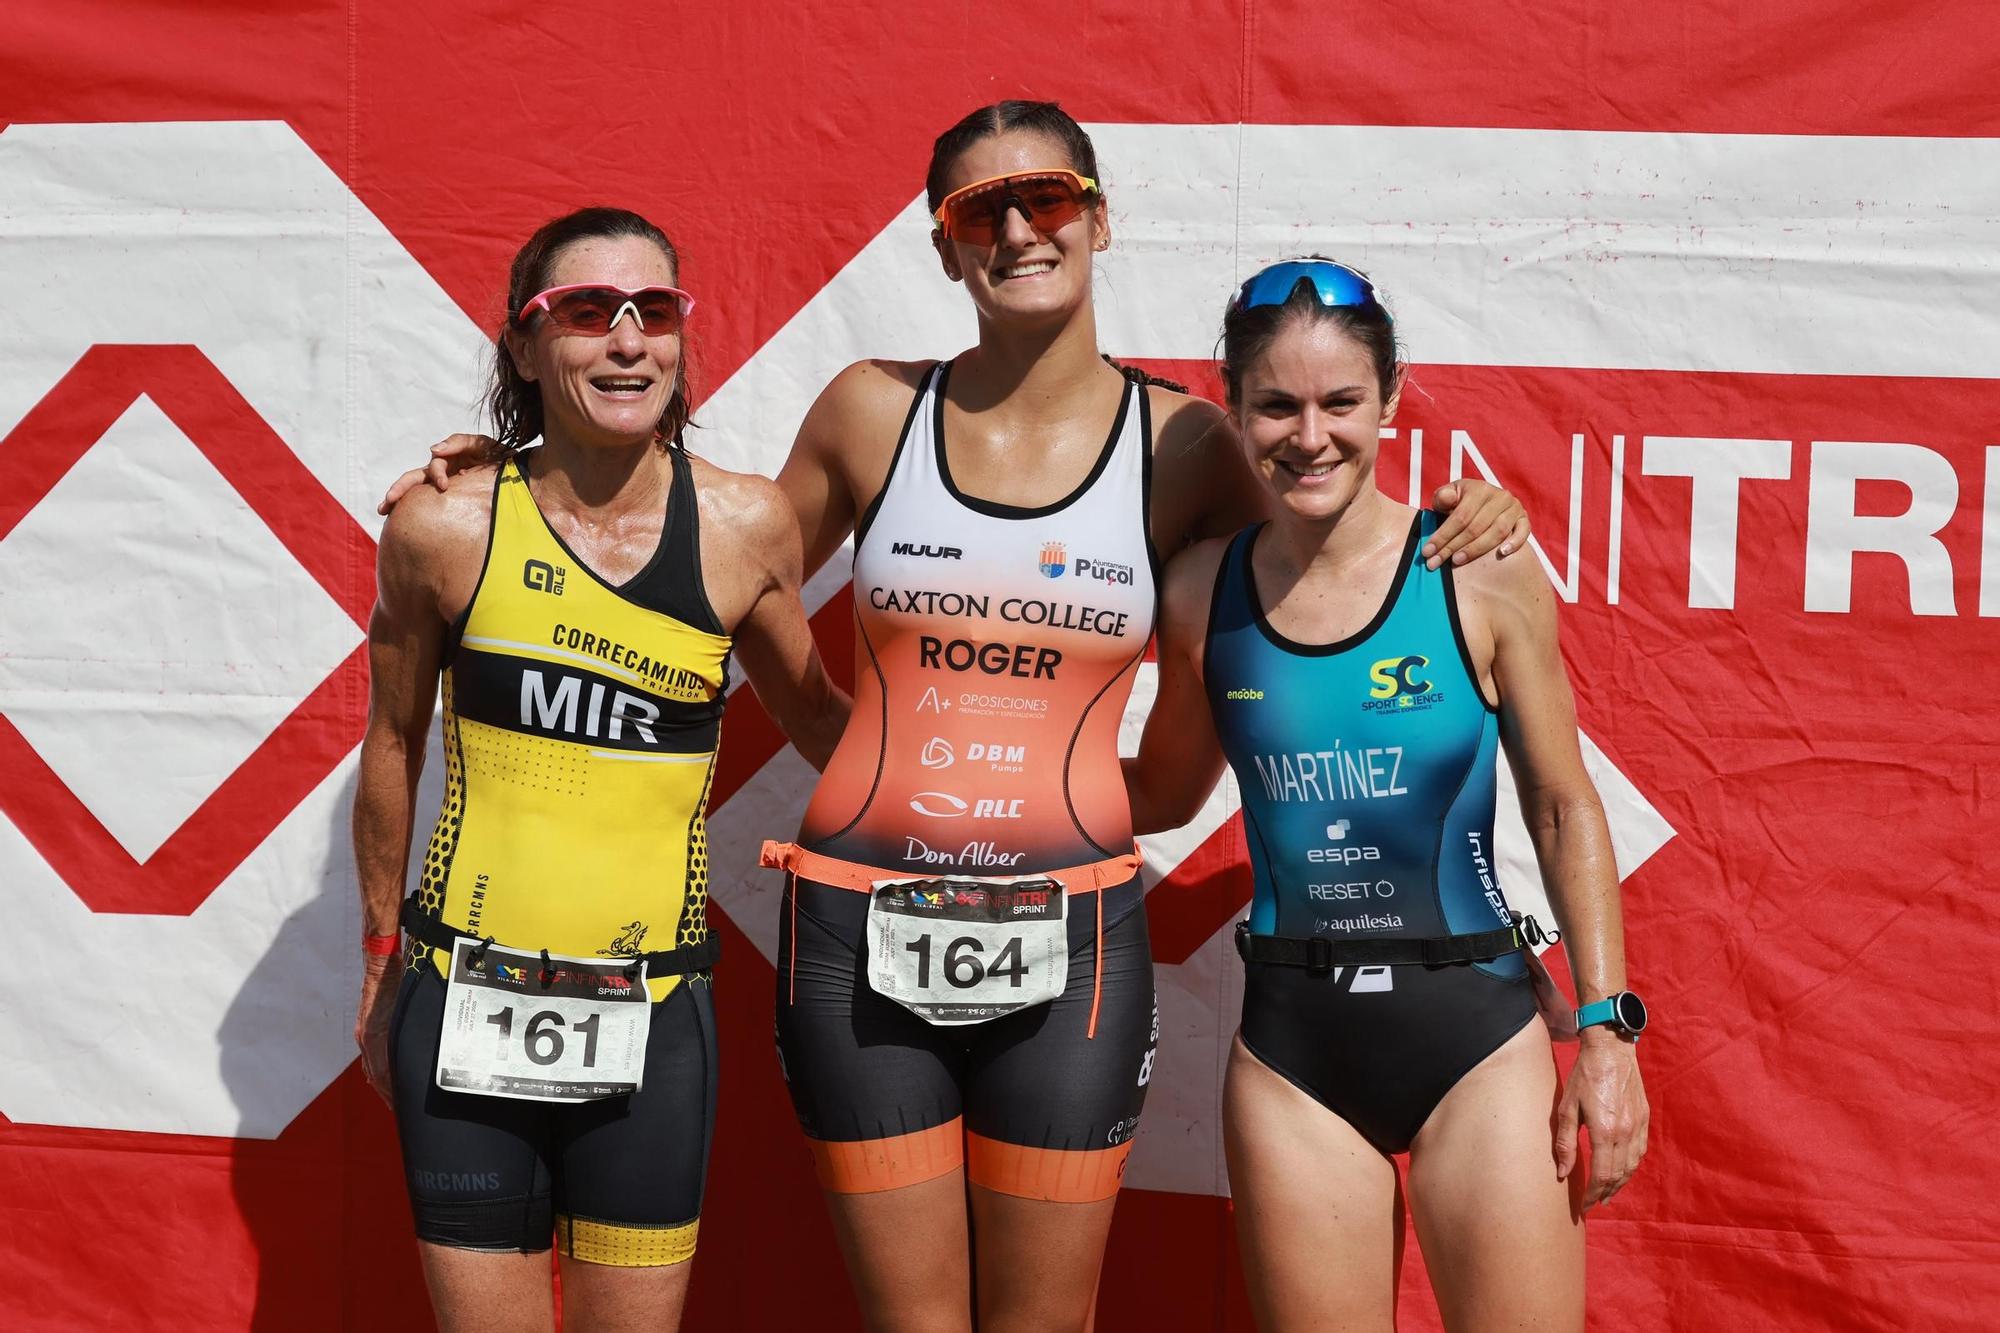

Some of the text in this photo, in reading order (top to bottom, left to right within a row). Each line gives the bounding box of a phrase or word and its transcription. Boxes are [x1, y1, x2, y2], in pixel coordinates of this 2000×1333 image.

[891, 542, 963, 560] MUUR
[1075, 558, 1133, 586] Puçol
[870, 587, 1128, 638] CAXTON COLLEGE
[920, 636, 1062, 680] ROGER
[1370, 654, 1433, 699] SC
[641, 678, 700, 699] TRIATLÓN
[520, 668, 661, 744] MIR
[959, 693, 1048, 712] OPOSICIONES
[1361, 699, 1398, 712] SPORT
[967, 743, 1026, 763] DBM
[991, 764, 1024, 773] Pumps
[1254, 738, 1408, 802] MARTÍNEZ
[972, 799, 1025, 818] RLC
[902, 836, 1026, 867] Don Alber
[1306, 846, 1381, 866] espa
[1308, 882, 1372, 900] RESET
[1013, 905, 1047, 915] SPRINT
[1331, 913, 1404, 933] aquilesia
[905, 933, 1029, 989] 164
[597, 987, 631, 996] SPRINT
[486, 1005, 601, 1068] 161
